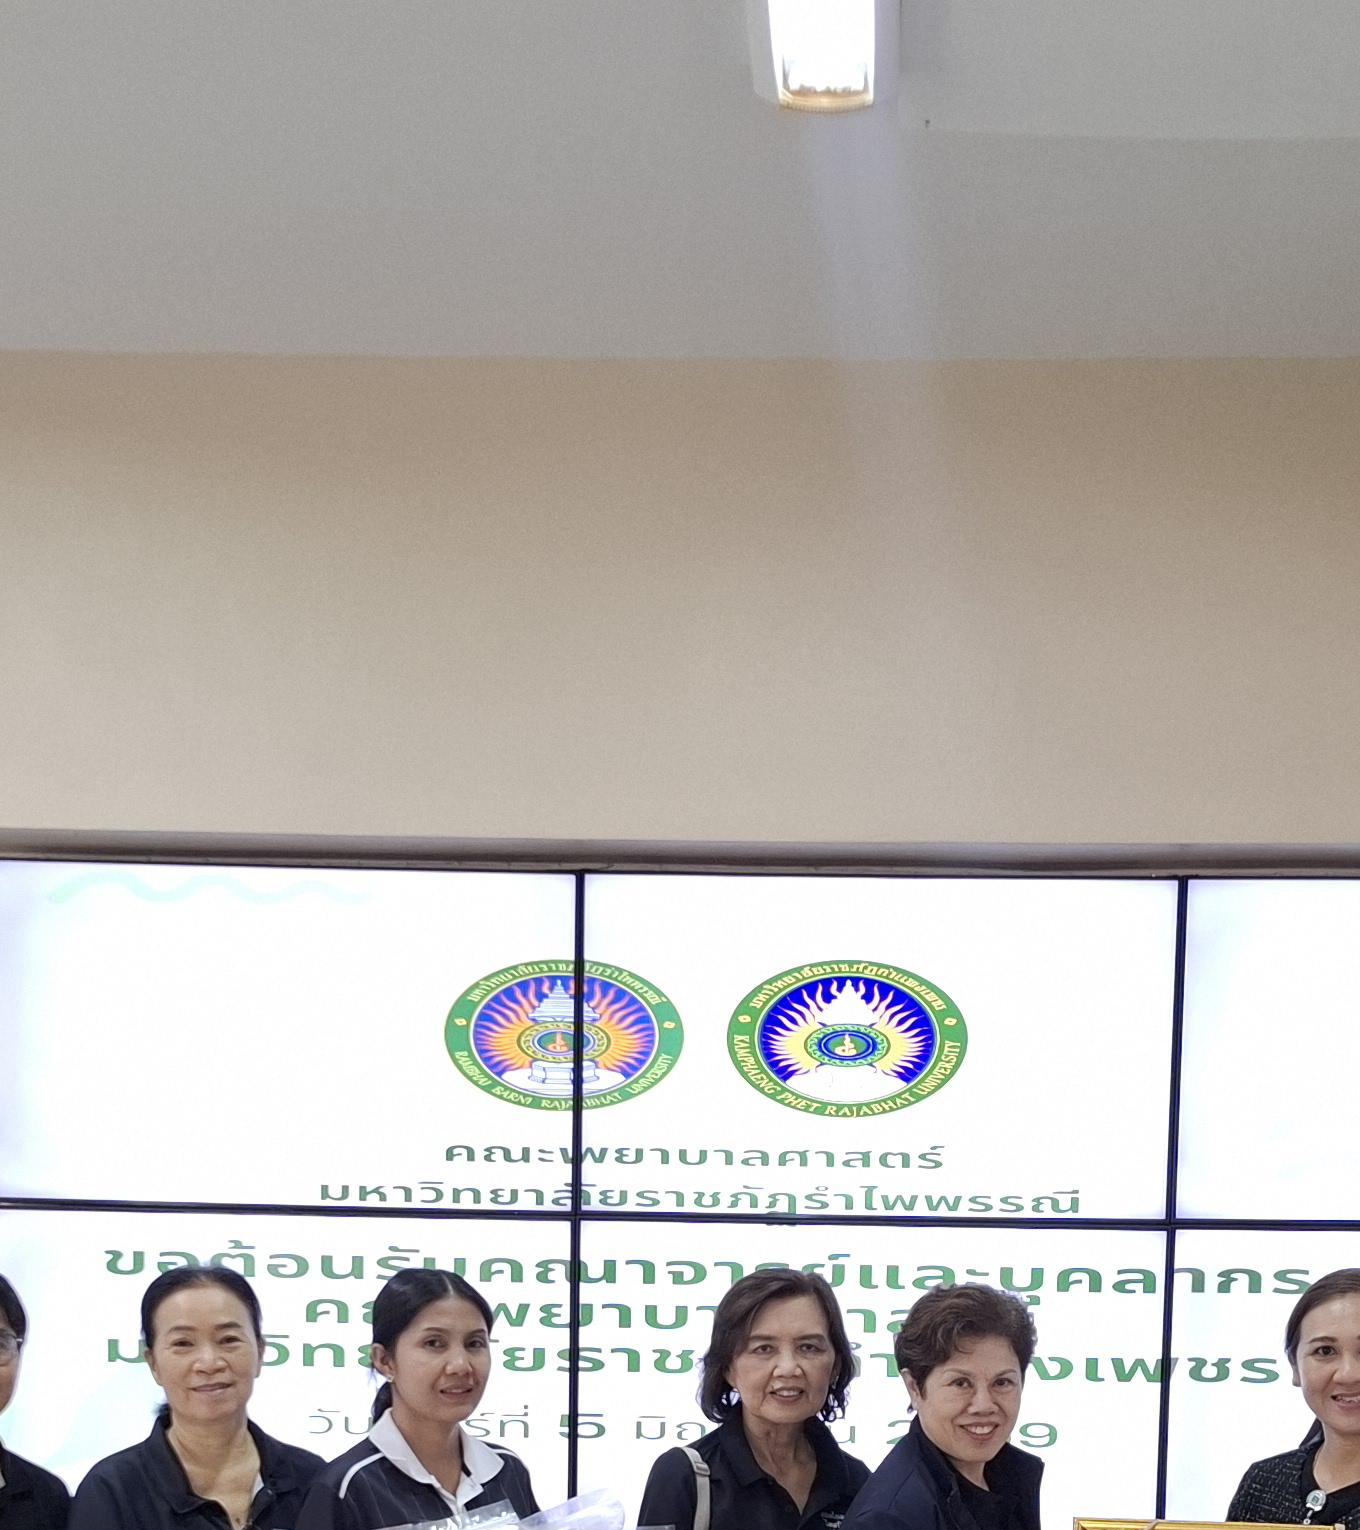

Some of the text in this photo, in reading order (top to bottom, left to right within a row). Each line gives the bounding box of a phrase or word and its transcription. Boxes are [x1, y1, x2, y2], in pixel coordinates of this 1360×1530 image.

[491, 1086, 533, 1106] BARNI
[624, 1053, 674, 1095] UNIVERSITY
[734, 1034, 962, 1118] KAMPHAENG PHET RAJABHAT UNIVERSITY
[444, 1143, 946, 1171] คณะพยาบาลศาสตร์
[558, 1412, 607, 1440] 5
